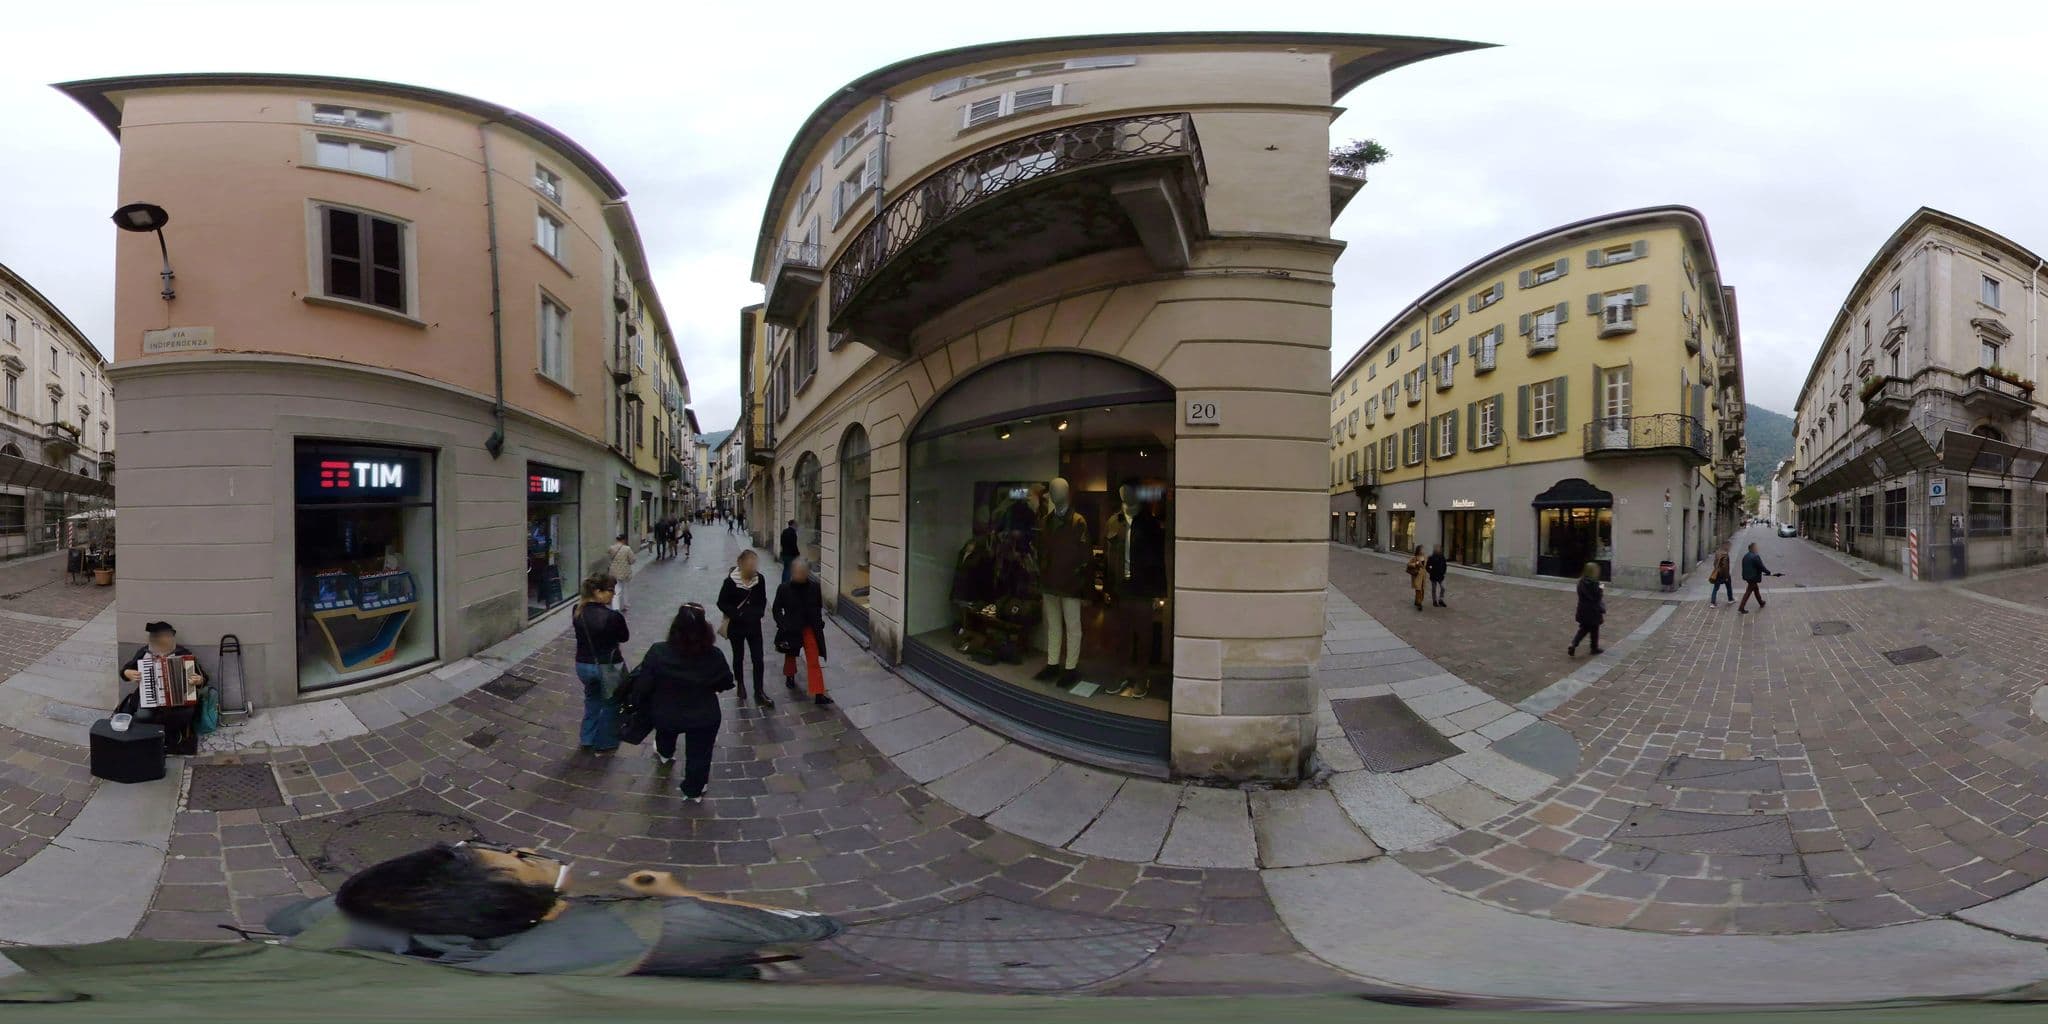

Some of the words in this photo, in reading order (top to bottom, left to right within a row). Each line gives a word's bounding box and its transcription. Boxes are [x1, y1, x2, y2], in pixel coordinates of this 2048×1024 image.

[150, 340, 208, 350] INDIPENDENZA
[1192, 403, 1216, 419] 20
[353, 462, 402, 488] TIM
[541, 477, 560, 493] TIM
